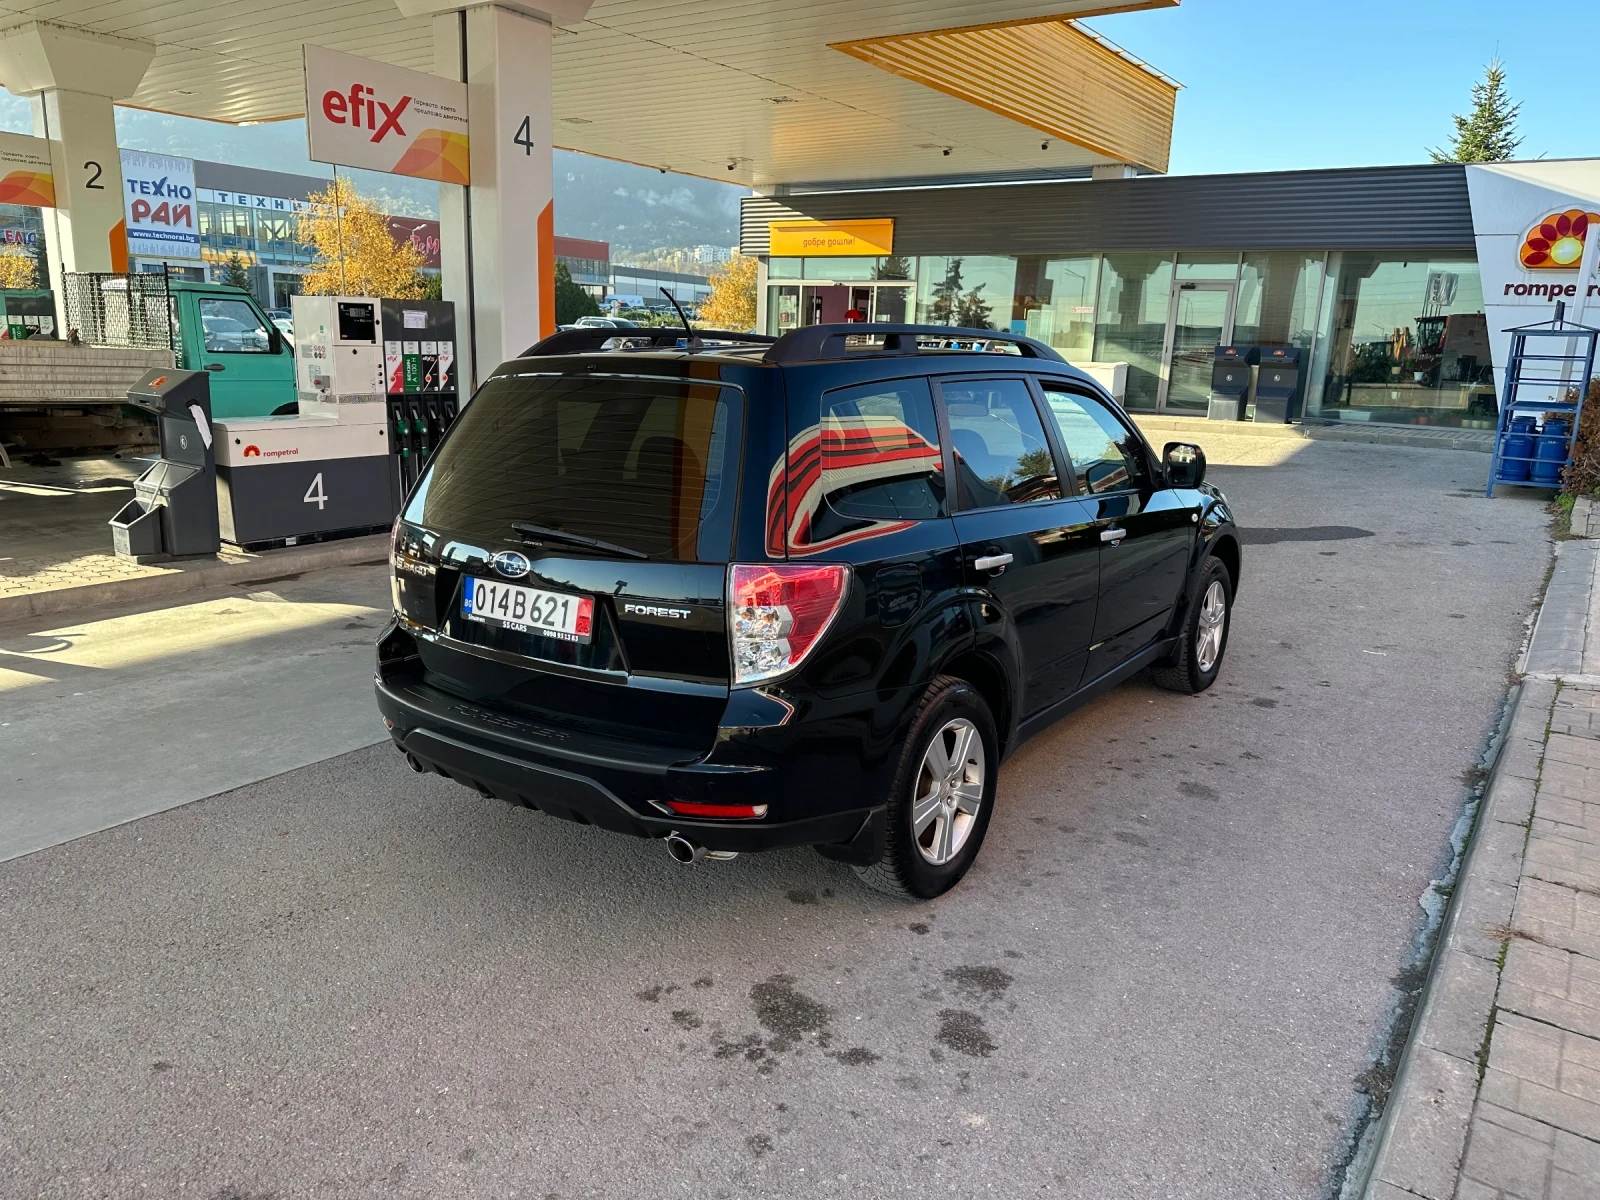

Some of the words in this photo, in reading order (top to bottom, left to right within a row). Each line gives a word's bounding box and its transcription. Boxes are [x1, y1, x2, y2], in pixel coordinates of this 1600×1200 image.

[322, 83, 412, 143] efix
[513, 115, 534, 156] 4
[83, 160, 105, 190] 2
[126, 176, 192, 200] ТЕХНО
[131, 198, 193, 228] РАЙ
[802, 237, 826, 248] добре
[827, 236, 856, 248] дошли!
[1503, 283, 1600, 302] romper
[263, 447, 299, 458] rompetrol
[303, 472, 328, 510] 4
[475, 583, 570, 629] 014B621
[624, 603, 691, 619] FOREST
